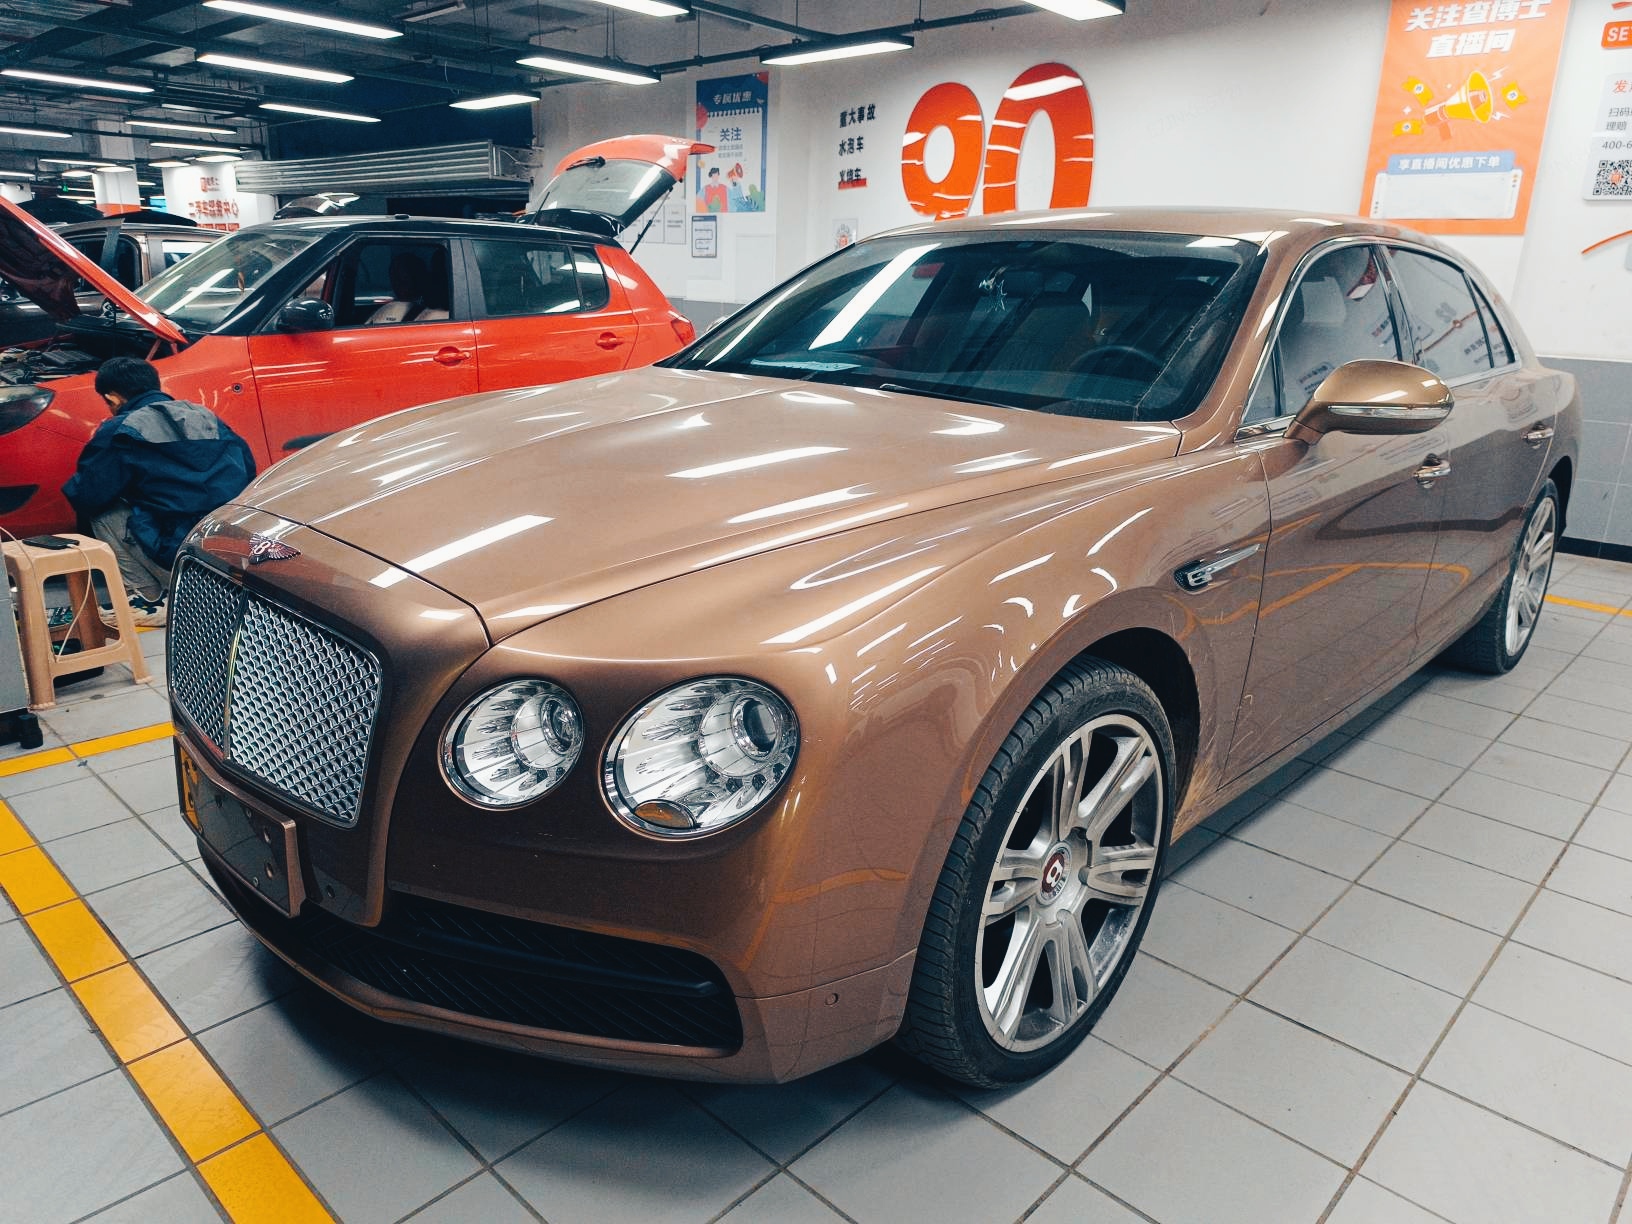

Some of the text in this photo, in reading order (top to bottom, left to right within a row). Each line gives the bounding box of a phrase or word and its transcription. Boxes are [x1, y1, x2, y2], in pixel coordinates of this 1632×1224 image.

[1405, 0, 1552, 32] 关注查博士
[1607, 26, 1632, 42] SE
[1426, 29, 1516, 58] 直播间
[1613, 79, 1632, 93] 发
[839, 103, 877, 128] 重大事故
[1608, 107, 1632, 118] 扫码
[720, 127, 742, 142] 关注
[1399, 156, 1501, 170] 享直播间优惠下单
